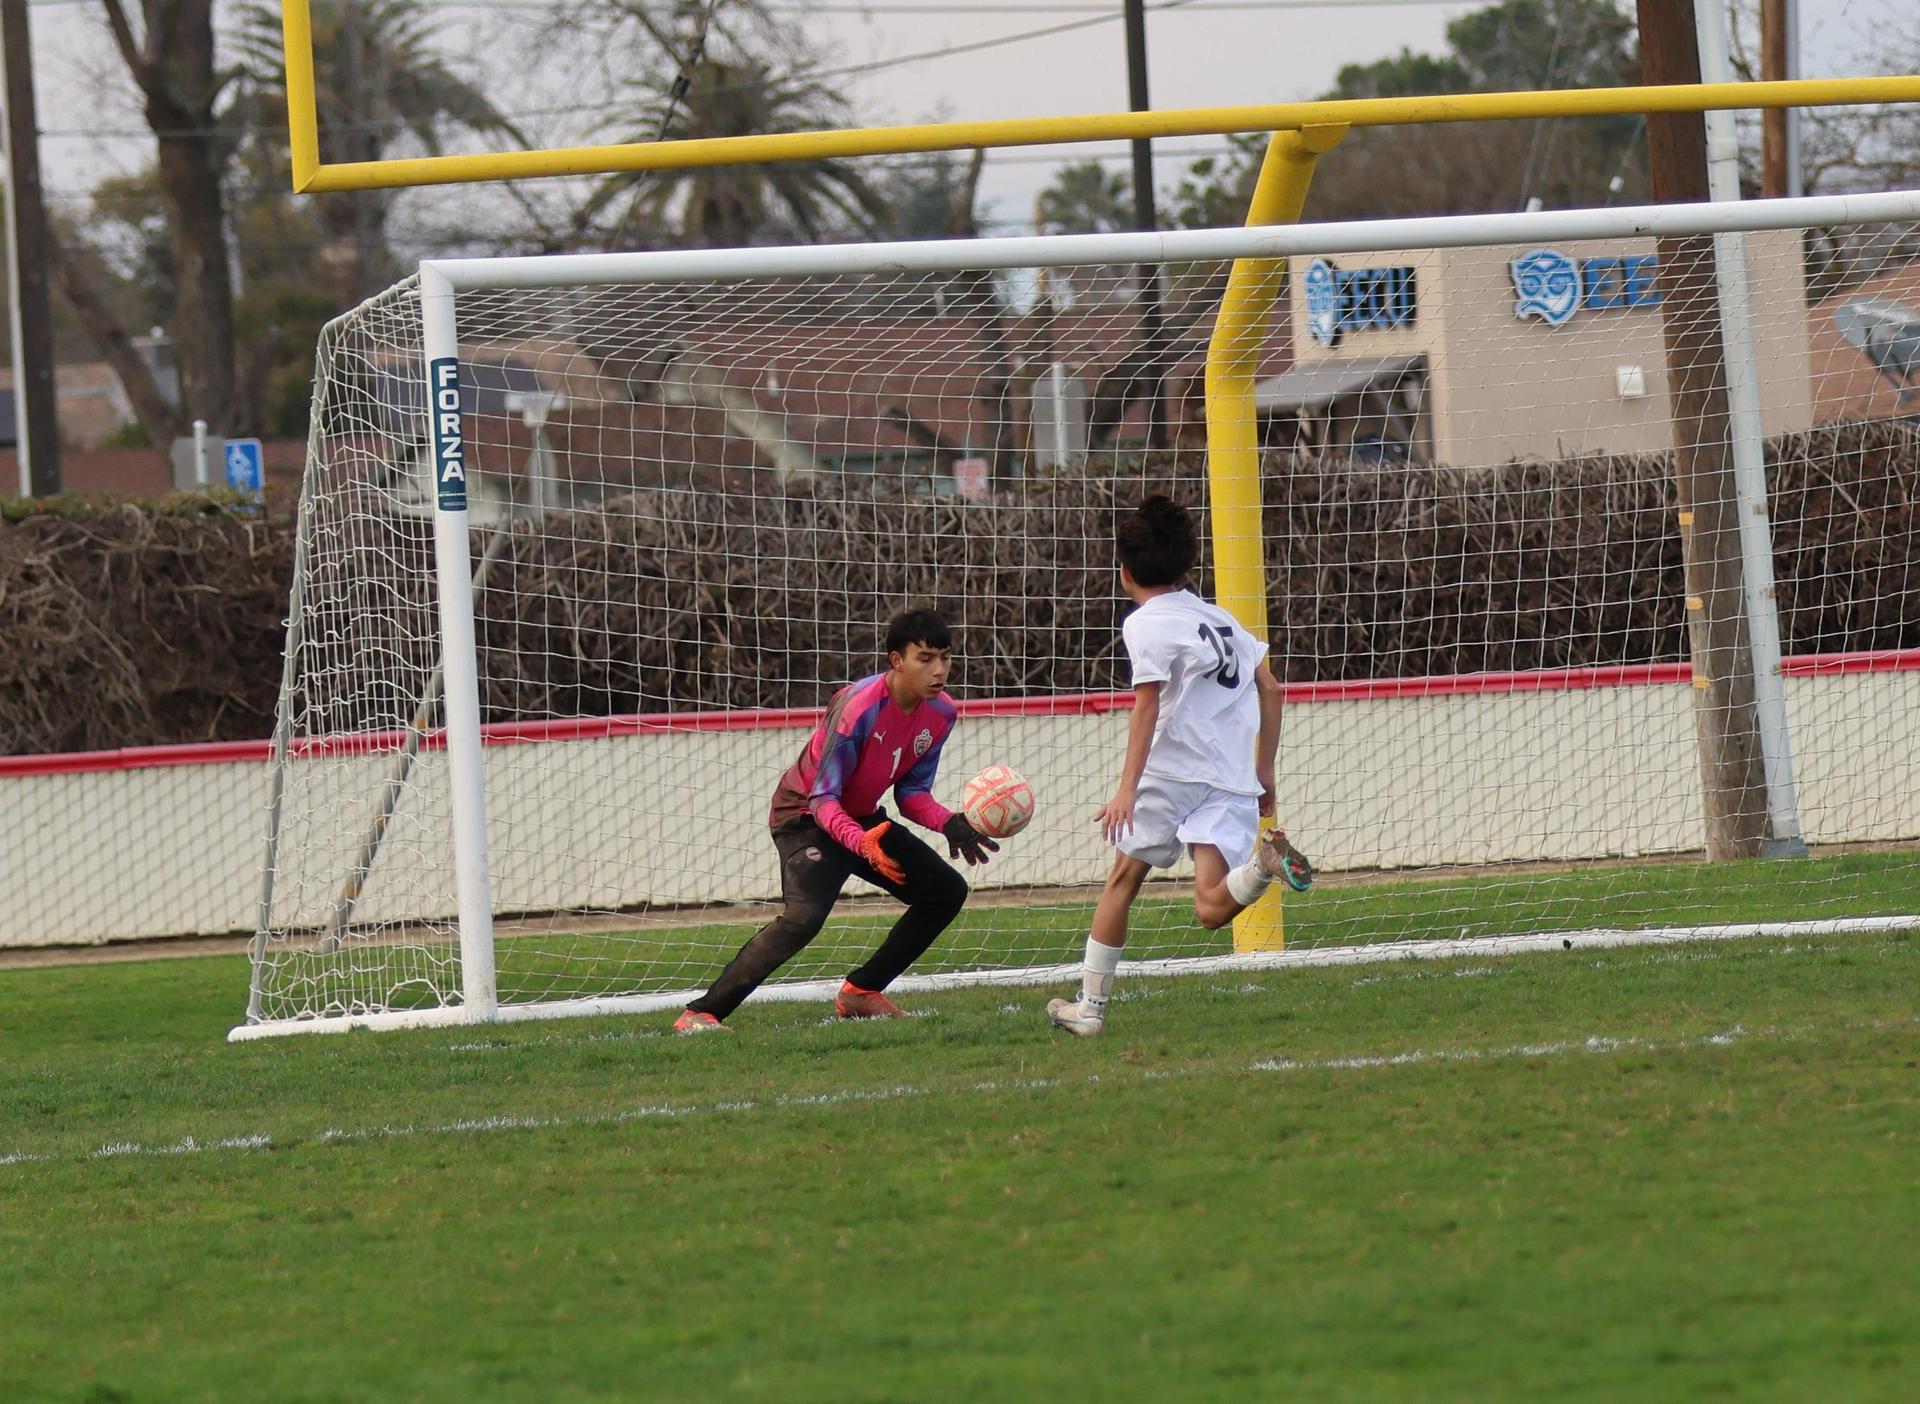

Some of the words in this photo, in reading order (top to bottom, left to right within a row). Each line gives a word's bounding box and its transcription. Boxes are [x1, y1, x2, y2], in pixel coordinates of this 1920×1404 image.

[1583, 256, 1663, 307] EE
[438, 365, 465, 482] FORZA
[1198, 623, 1240, 689] 15
[890, 747, 902, 779] 1
